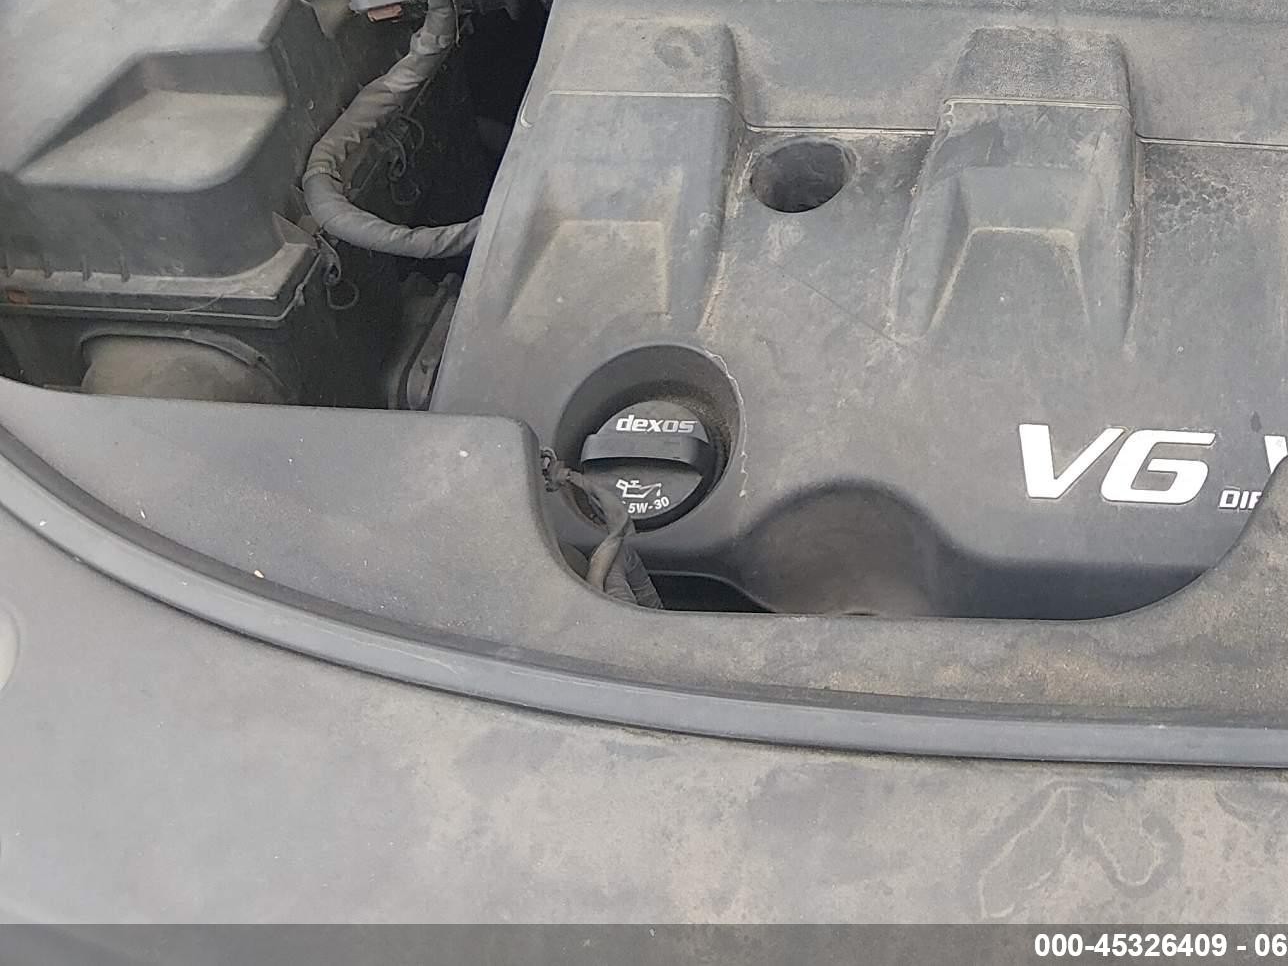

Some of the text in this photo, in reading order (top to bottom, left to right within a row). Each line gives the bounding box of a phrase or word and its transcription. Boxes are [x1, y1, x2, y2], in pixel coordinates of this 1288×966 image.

[616, 414, 695, 433] dexos
[1018, 423, 1216, 505] V6
[628, 496, 670, 514] 5W-30
